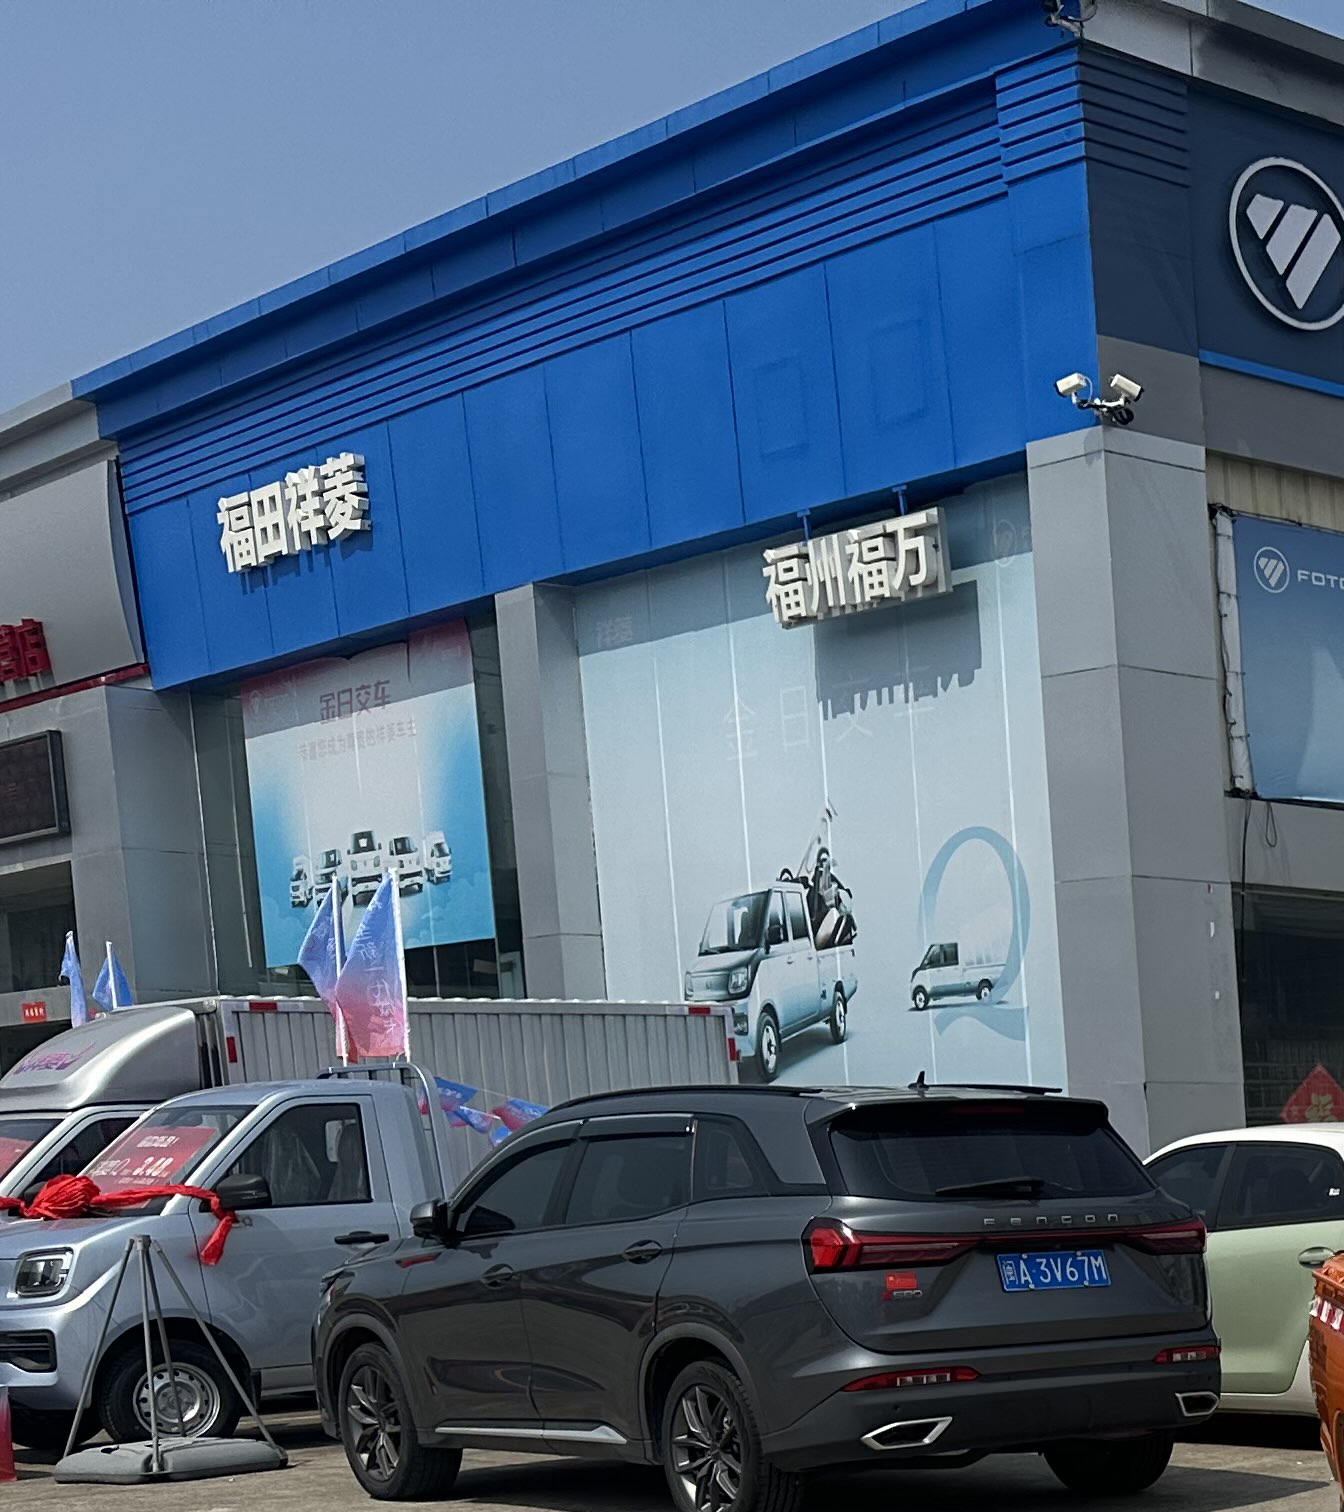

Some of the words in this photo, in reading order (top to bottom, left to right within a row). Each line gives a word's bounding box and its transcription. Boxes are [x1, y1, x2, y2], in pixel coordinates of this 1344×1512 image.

[217, 452, 372, 573] 福田祥菱
[762, 507, 948, 626] 福州福万
